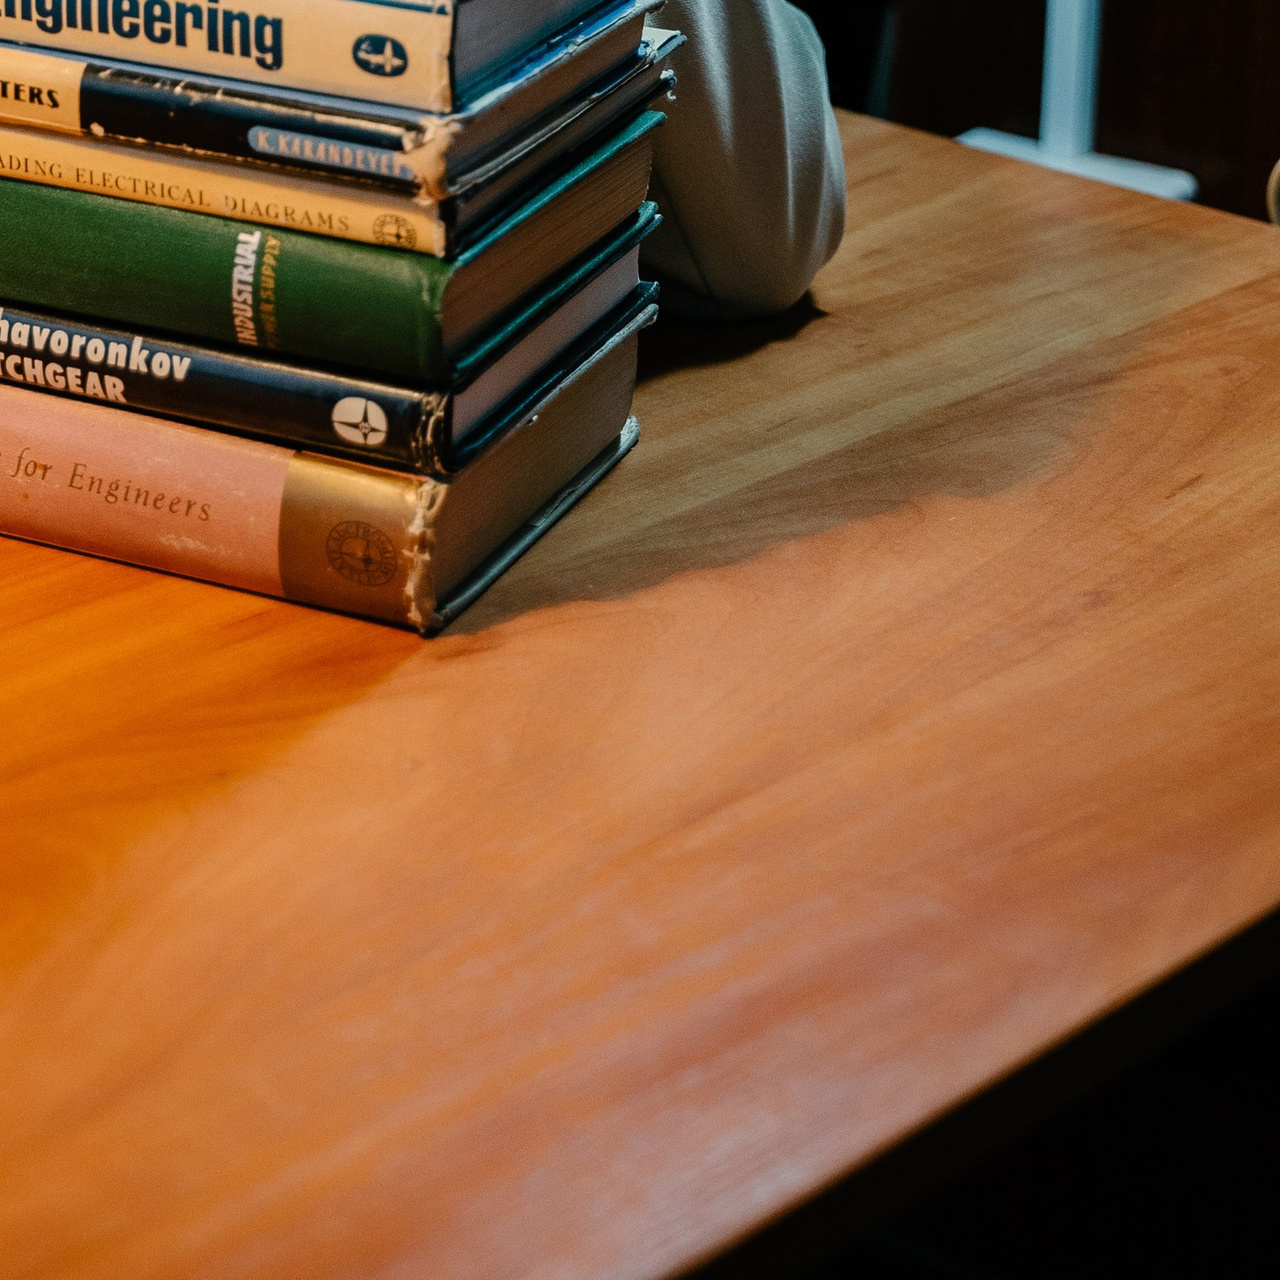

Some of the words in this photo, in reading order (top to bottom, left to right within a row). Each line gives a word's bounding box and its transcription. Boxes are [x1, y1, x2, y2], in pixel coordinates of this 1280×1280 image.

[75, 168, 211, 208] ELECTRICAL
[224, 195, 350, 232] DIAGRAMS
[232, 230, 261, 347] INDUSTRIAL
[13, 445, 51, 481] for
[67, 462, 211, 523] Engineers
